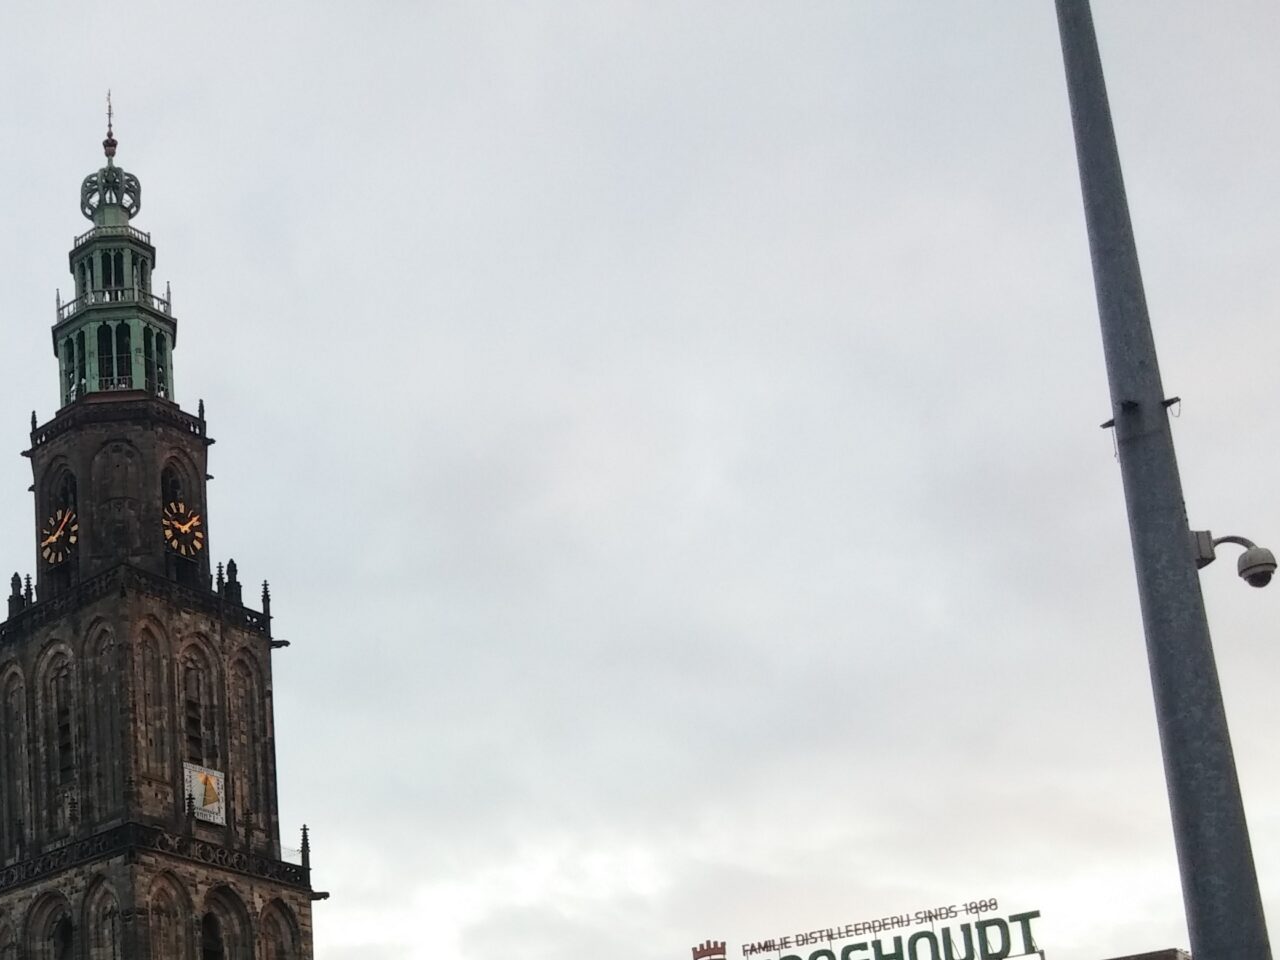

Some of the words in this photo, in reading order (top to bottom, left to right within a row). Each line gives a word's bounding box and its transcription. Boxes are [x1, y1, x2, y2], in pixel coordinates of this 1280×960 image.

[742, 935, 792, 956] FAMILIE
[795, 913, 910, 947] DISTILLEERDERIJ
[914, 904, 958, 925] SINDS
[964, 897, 998, 916] 1888
